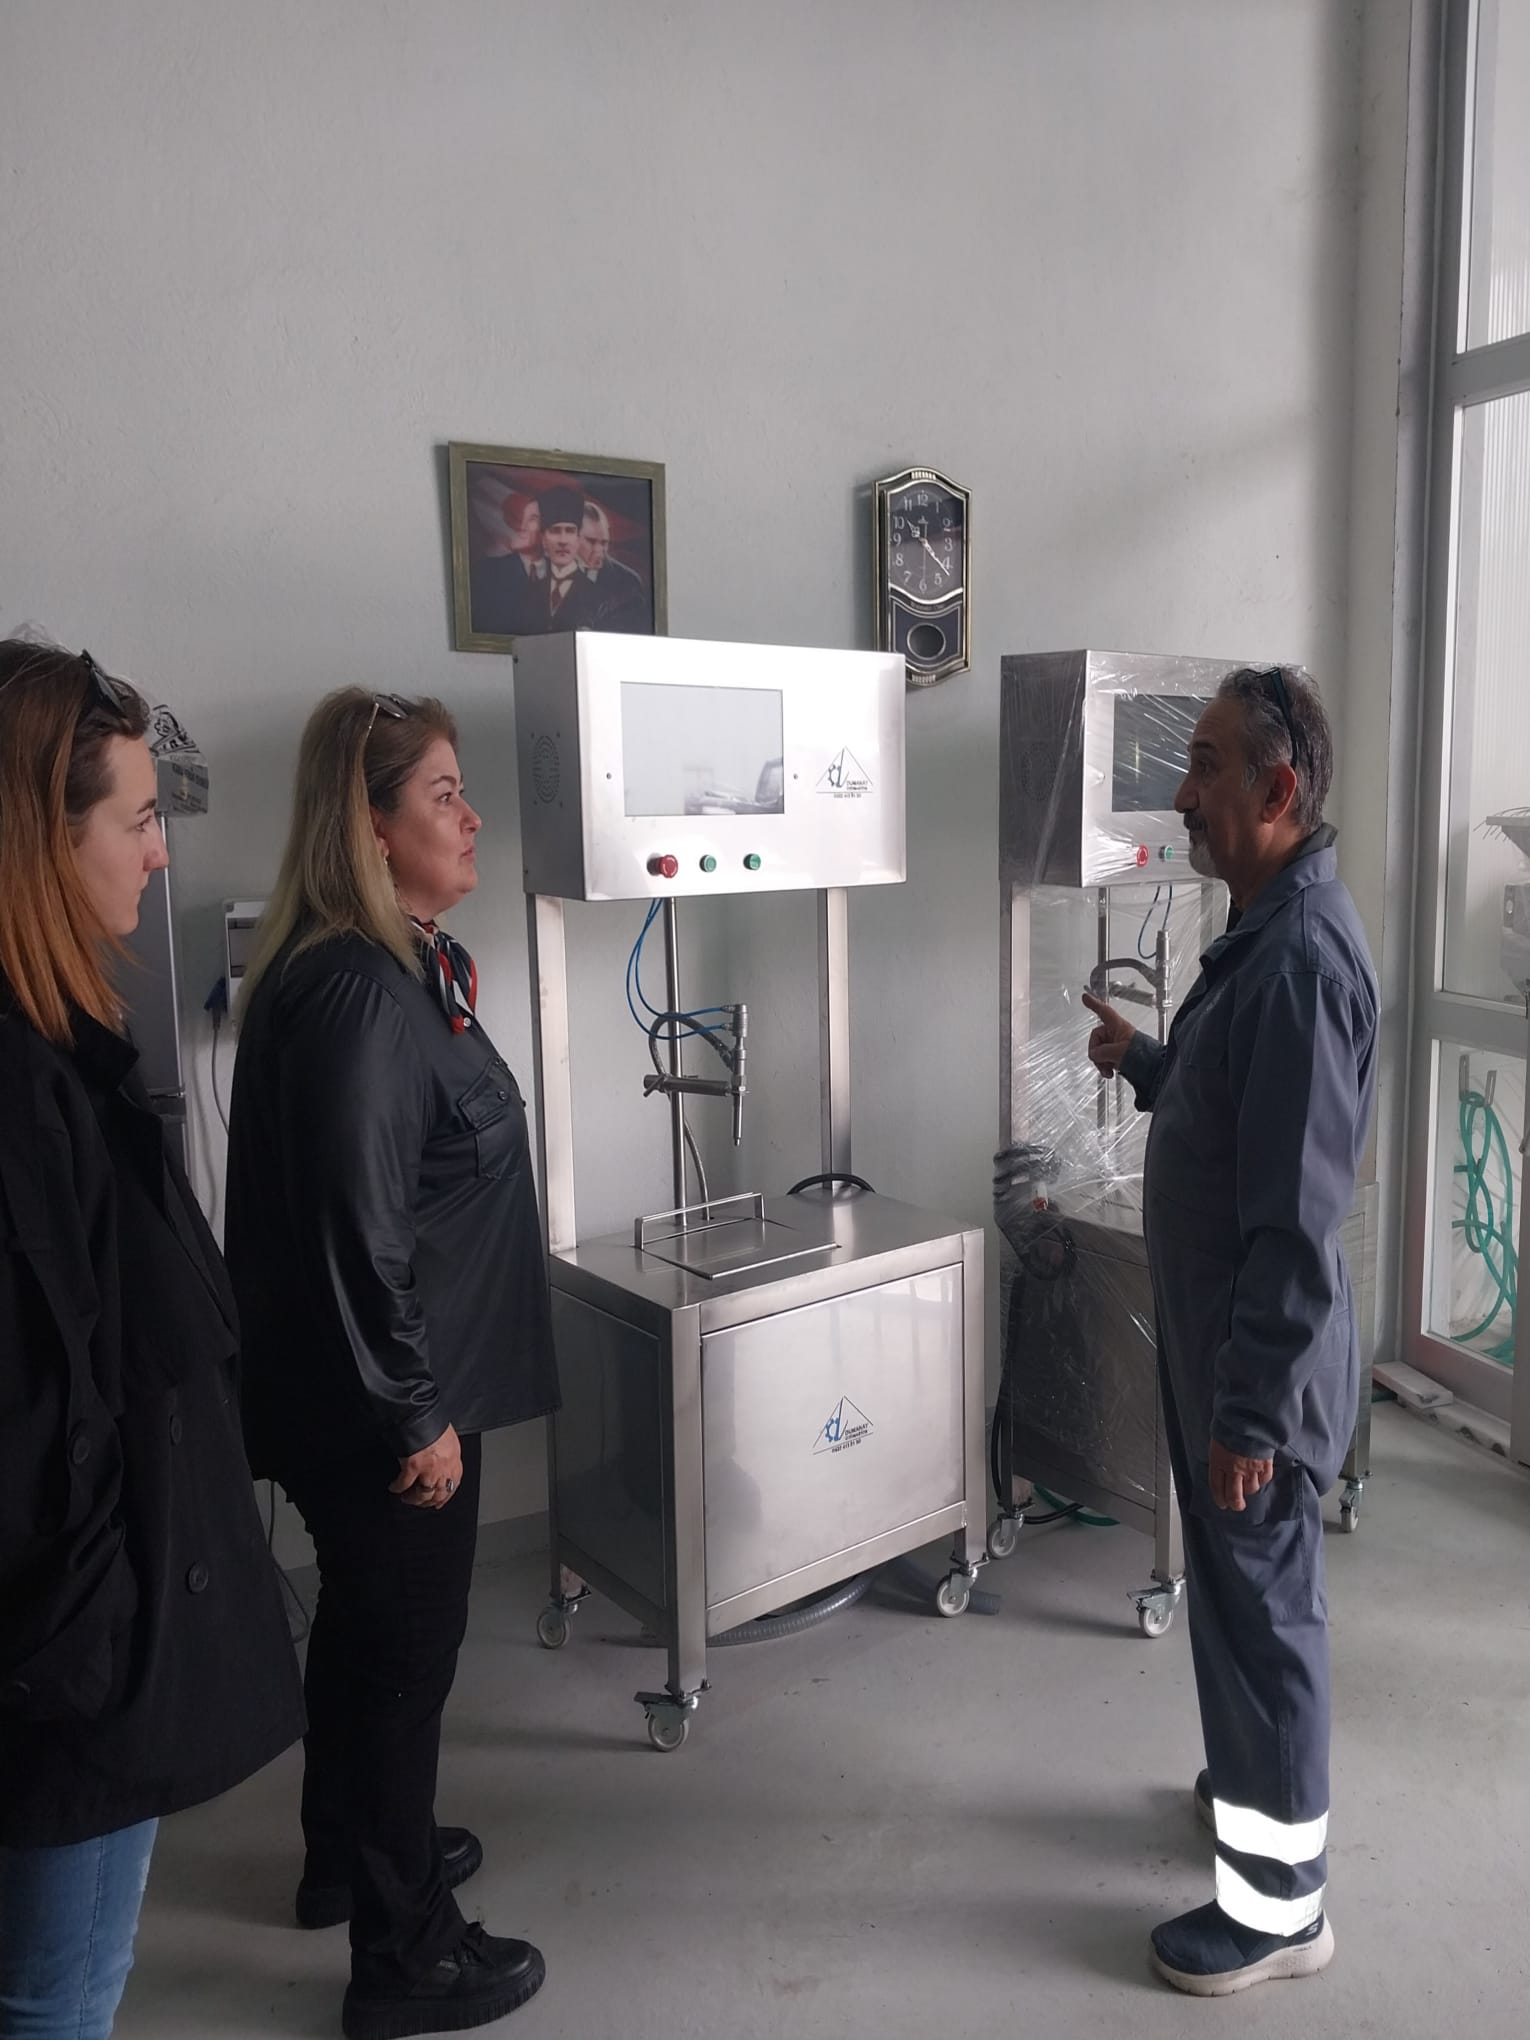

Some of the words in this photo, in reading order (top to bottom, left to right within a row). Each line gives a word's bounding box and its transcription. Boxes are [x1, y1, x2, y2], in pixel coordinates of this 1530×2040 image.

[903, 496, 913, 511] 11
[917, 492, 929, 507] 12
[893, 515, 905, 530] 10
[942, 517, 952, 532] 2
[893, 532, 902, 547] 9
[944, 537, 953, 552] 3
[895, 553, 904, 567] 8
[942, 556, 954, 570] 4
[903, 570, 912, 585] 7
[934, 572, 942, 585] 5
[919, 579, 928, 592] 6
